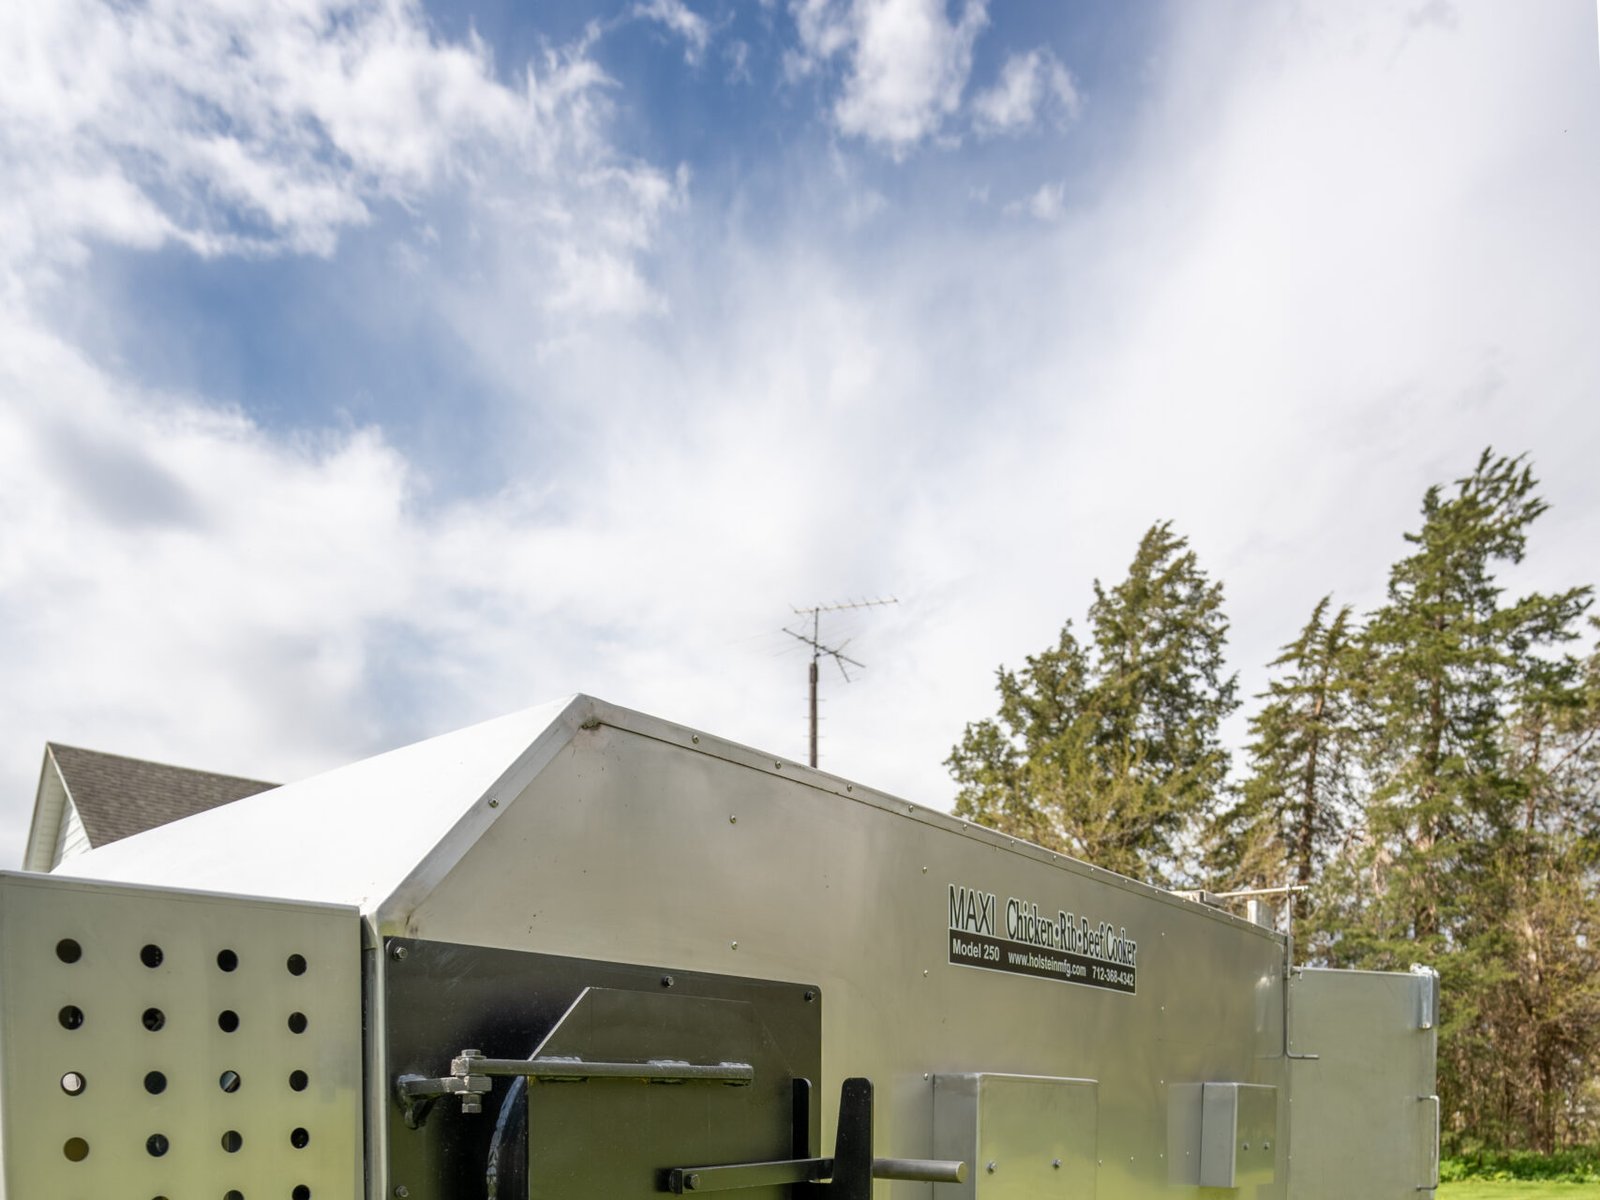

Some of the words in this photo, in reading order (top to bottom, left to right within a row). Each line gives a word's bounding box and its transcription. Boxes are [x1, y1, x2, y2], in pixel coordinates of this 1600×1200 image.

[950, 885, 995, 936] MAXI
[1106, 927, 1136, 965] Cooker
[953, 939, 982, 957] Model
[984, 946, 1000, 961] 250
[1008, 952, 1086, 977] www.holsteinmfg.com
[1092, 966, 1134, 986] 712-368-4342
